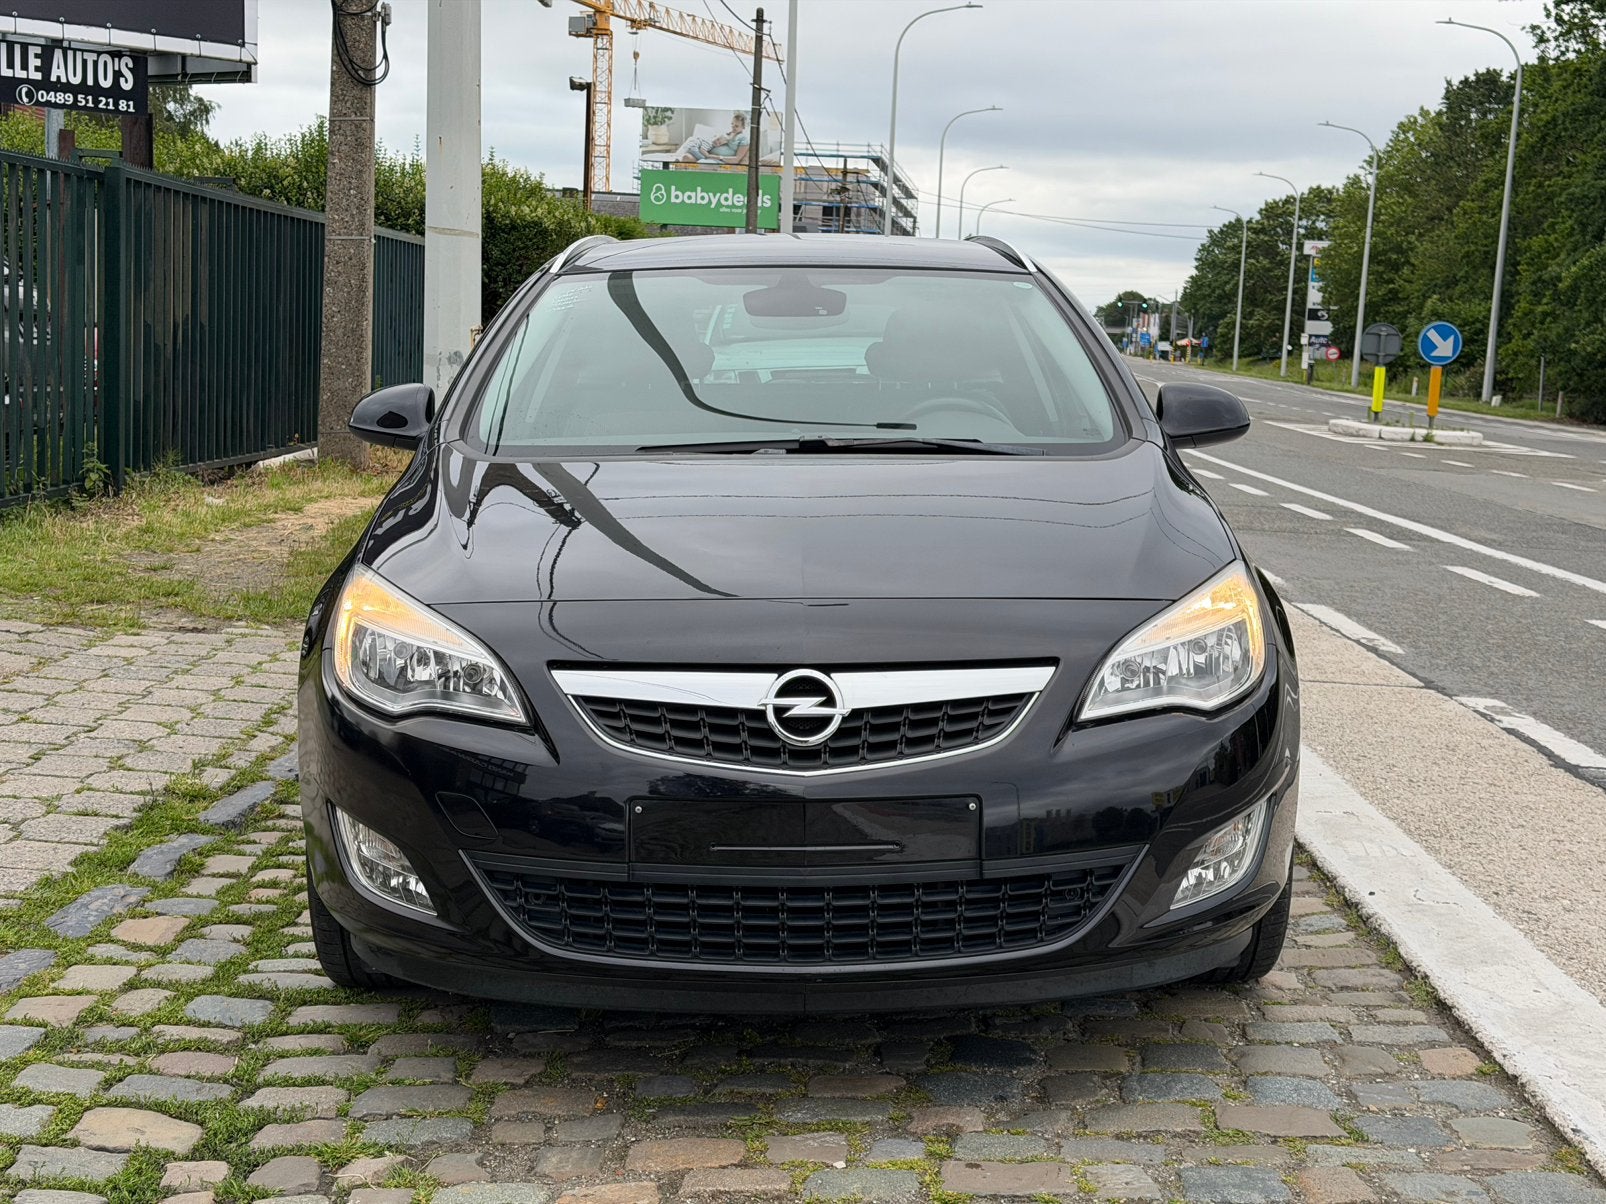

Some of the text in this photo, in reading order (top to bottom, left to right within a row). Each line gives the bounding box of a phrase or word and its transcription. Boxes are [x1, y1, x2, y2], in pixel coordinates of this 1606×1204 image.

[0, 42, 134, 91] LLE AUTO'S
[38, 90, 136, 113] 0489 51 21 81
[671, 185, 771, 209] babydels
